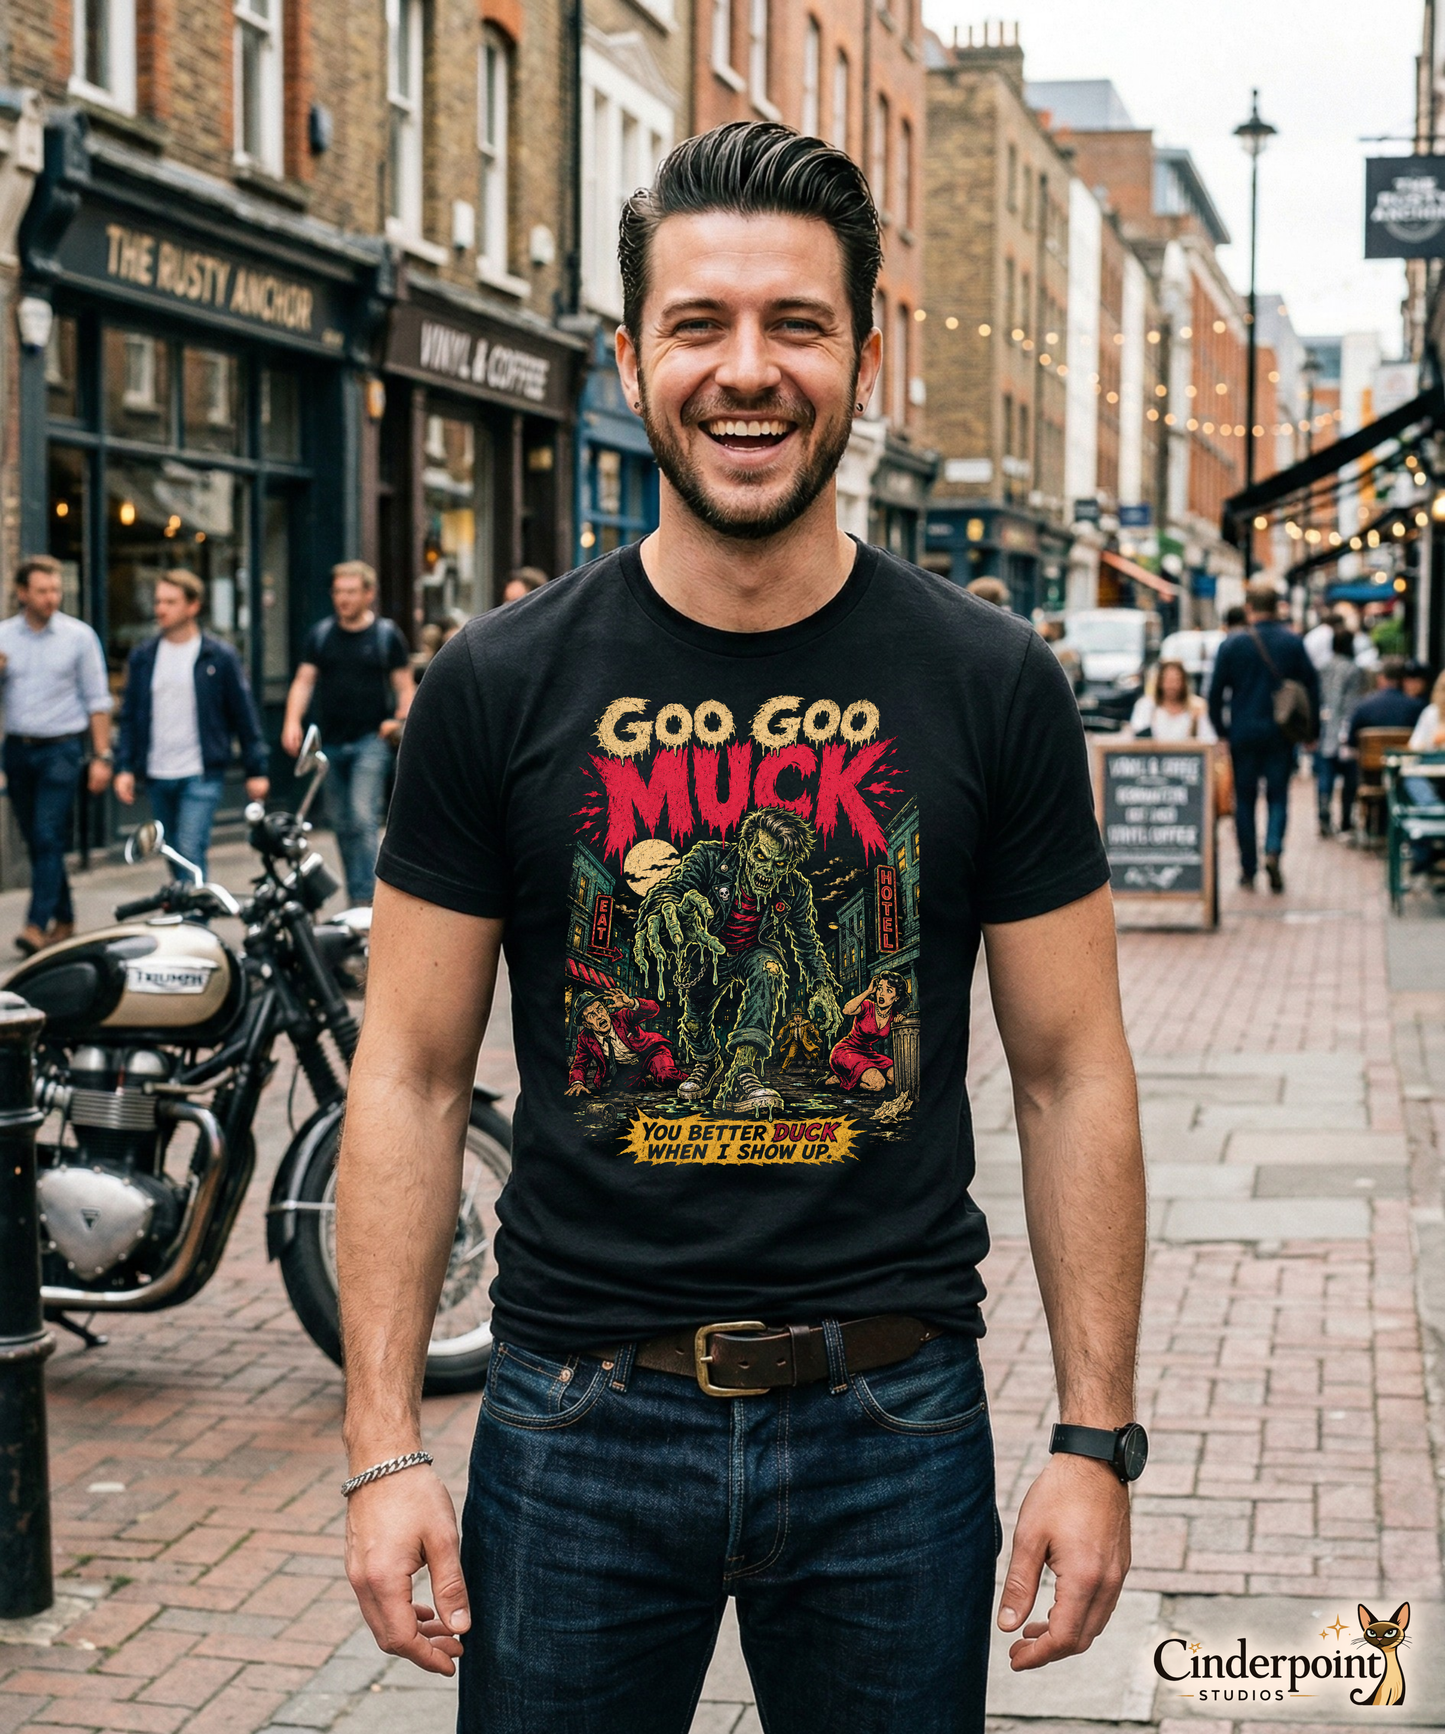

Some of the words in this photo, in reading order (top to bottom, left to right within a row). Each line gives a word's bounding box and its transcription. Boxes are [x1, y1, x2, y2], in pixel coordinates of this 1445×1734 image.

[106, 223, 154, 287] THE
[156, 240, 231, 308] RUSTY
[229, 267, 313, 333] ANCHOR
[420, 319, 471, 380] VINYL
[590, 696, 737, 767] GOO
[748, 695, 880, 757] GOO
[587, 735, 898, 876] MUCK
[596, 899, 609, 940] EAT
[880, 869, 894, 949] HOTEL
[136, 971, 203, 985] TRIUMPH
[643, 1121, 682, 1142] YOU
[688, 1124, 767, 1142] BETTER
[772, 1122, 842, 1143] DUCK
[648, 1143, 708, 1160] WHEN
[716, 1143, 729, 1160] I
[736, 1143, 798, 1160] SHOW
[801, 1143, 832, 1160] UP.
